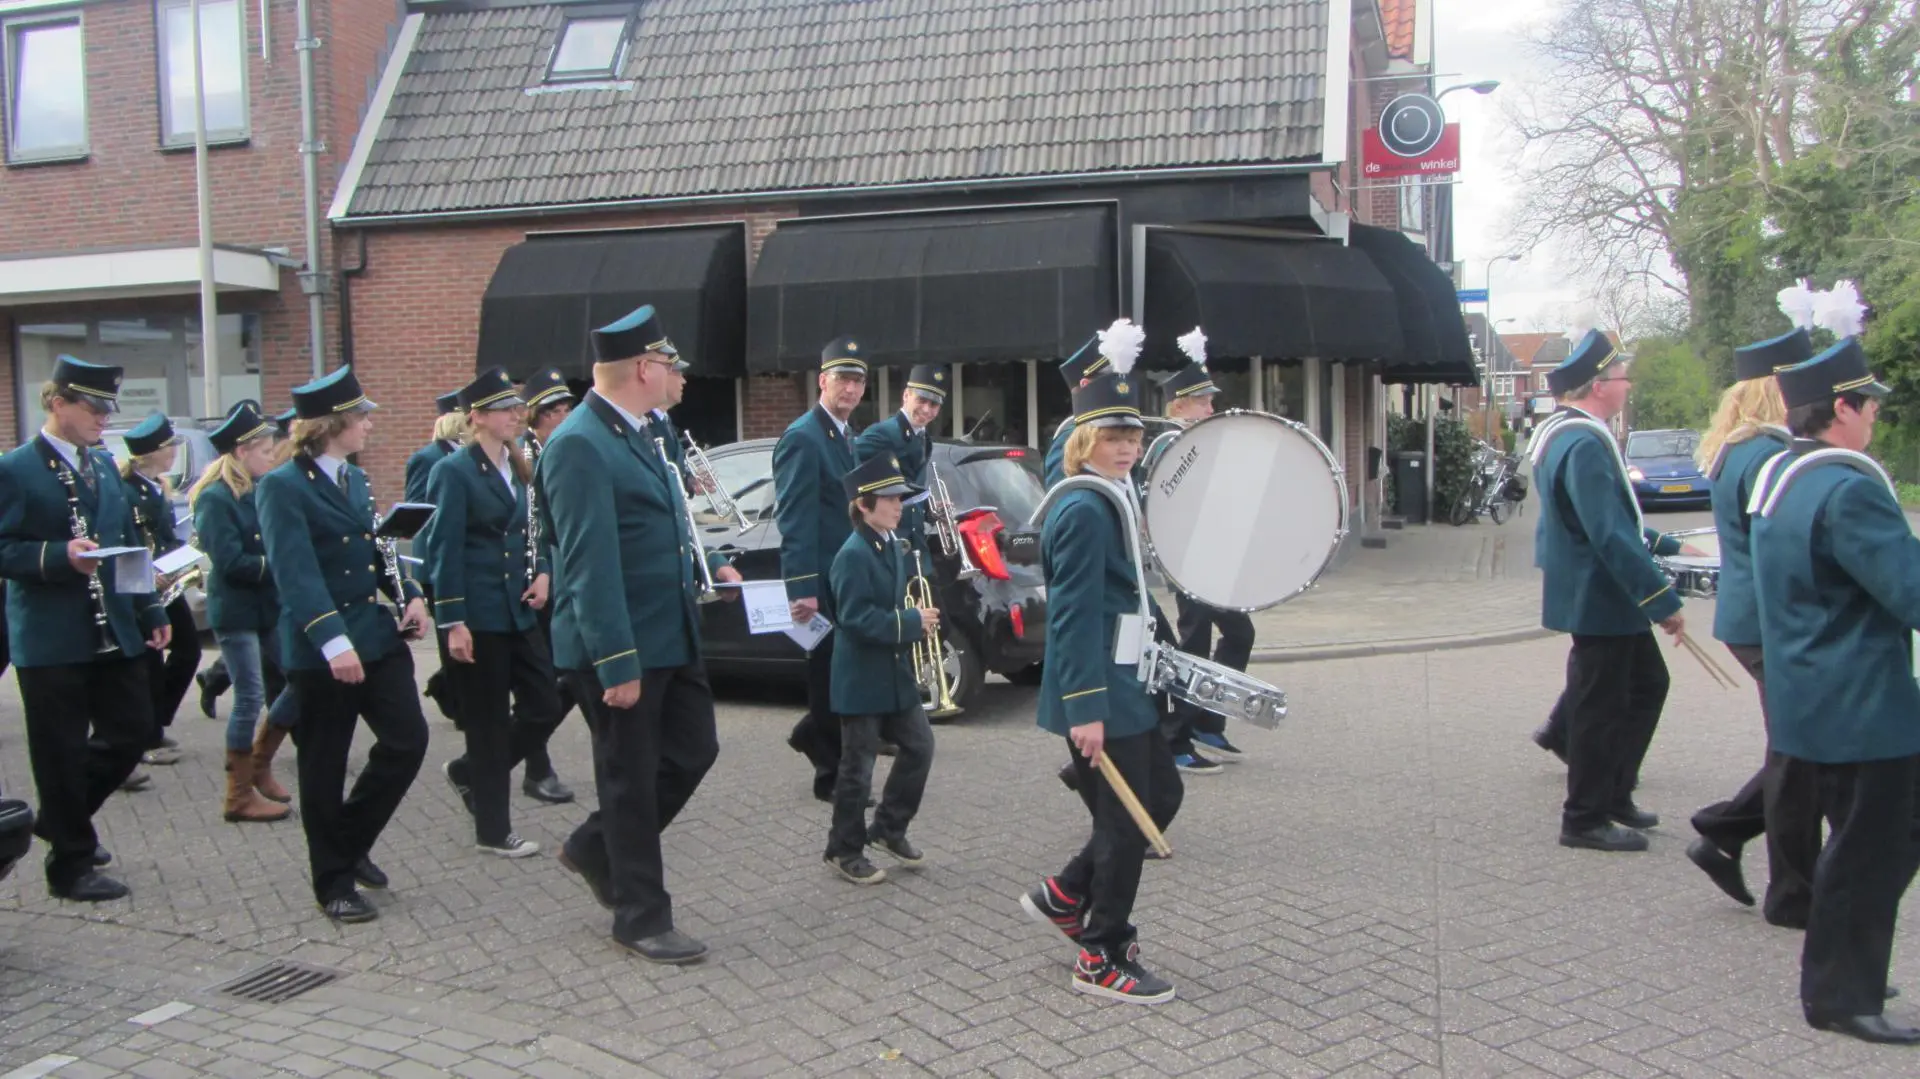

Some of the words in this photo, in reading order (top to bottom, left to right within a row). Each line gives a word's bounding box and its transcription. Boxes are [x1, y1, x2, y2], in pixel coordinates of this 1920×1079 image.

[1365, 162, 1380, 173] de
[1420, 158, 1457, 170] winkel
[1160, 445, 1200, 498] Premier
